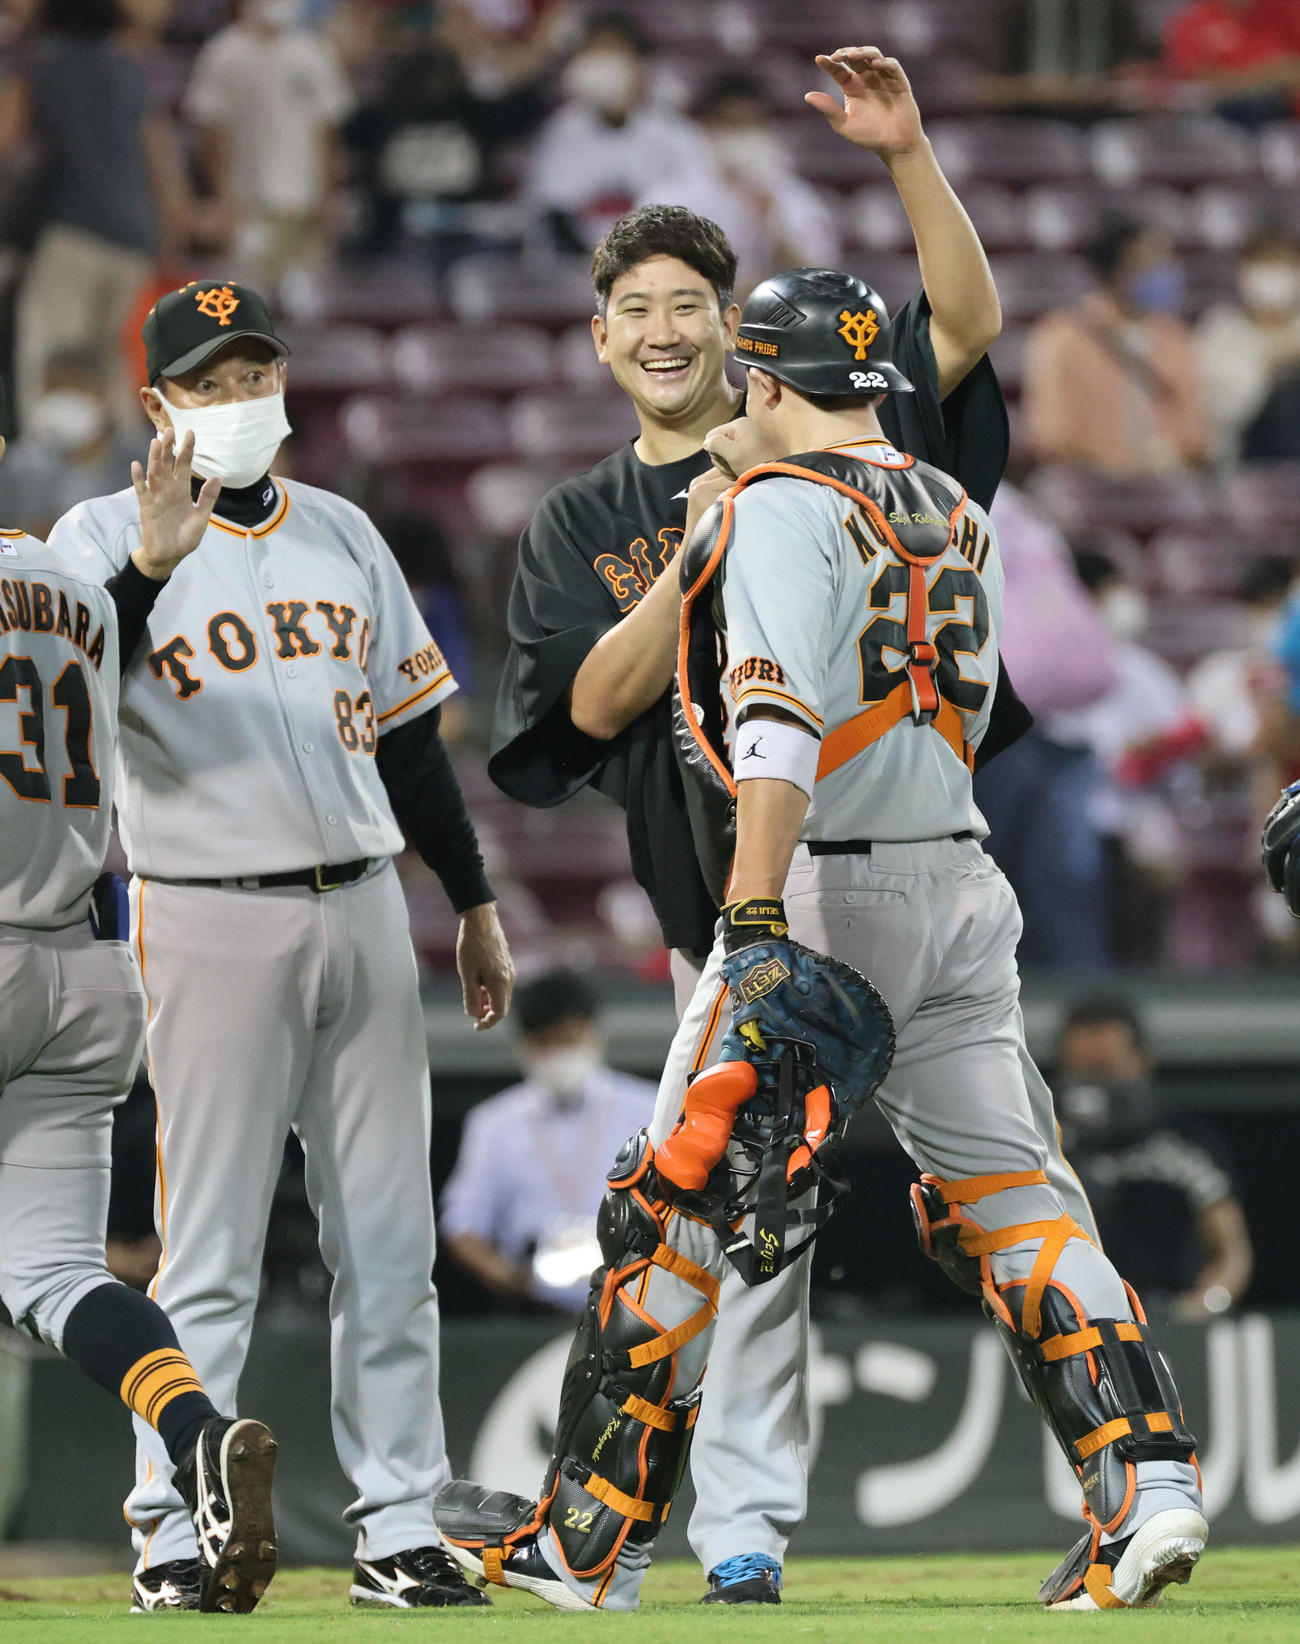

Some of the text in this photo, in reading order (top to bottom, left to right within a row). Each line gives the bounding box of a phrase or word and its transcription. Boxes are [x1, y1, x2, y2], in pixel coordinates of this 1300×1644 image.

[754, 341, 778, 358] PRIDE
[849, 371, 889, 389] 22
[856, 561, 991, 714] 22
[0, 653, 101, 810] 31
[334, 689, 378, 756] 83
[746, 906, 759, 915] 22
[745, 967, 784, 996] ZETT
[563, 1507, 594, 1534] 22
